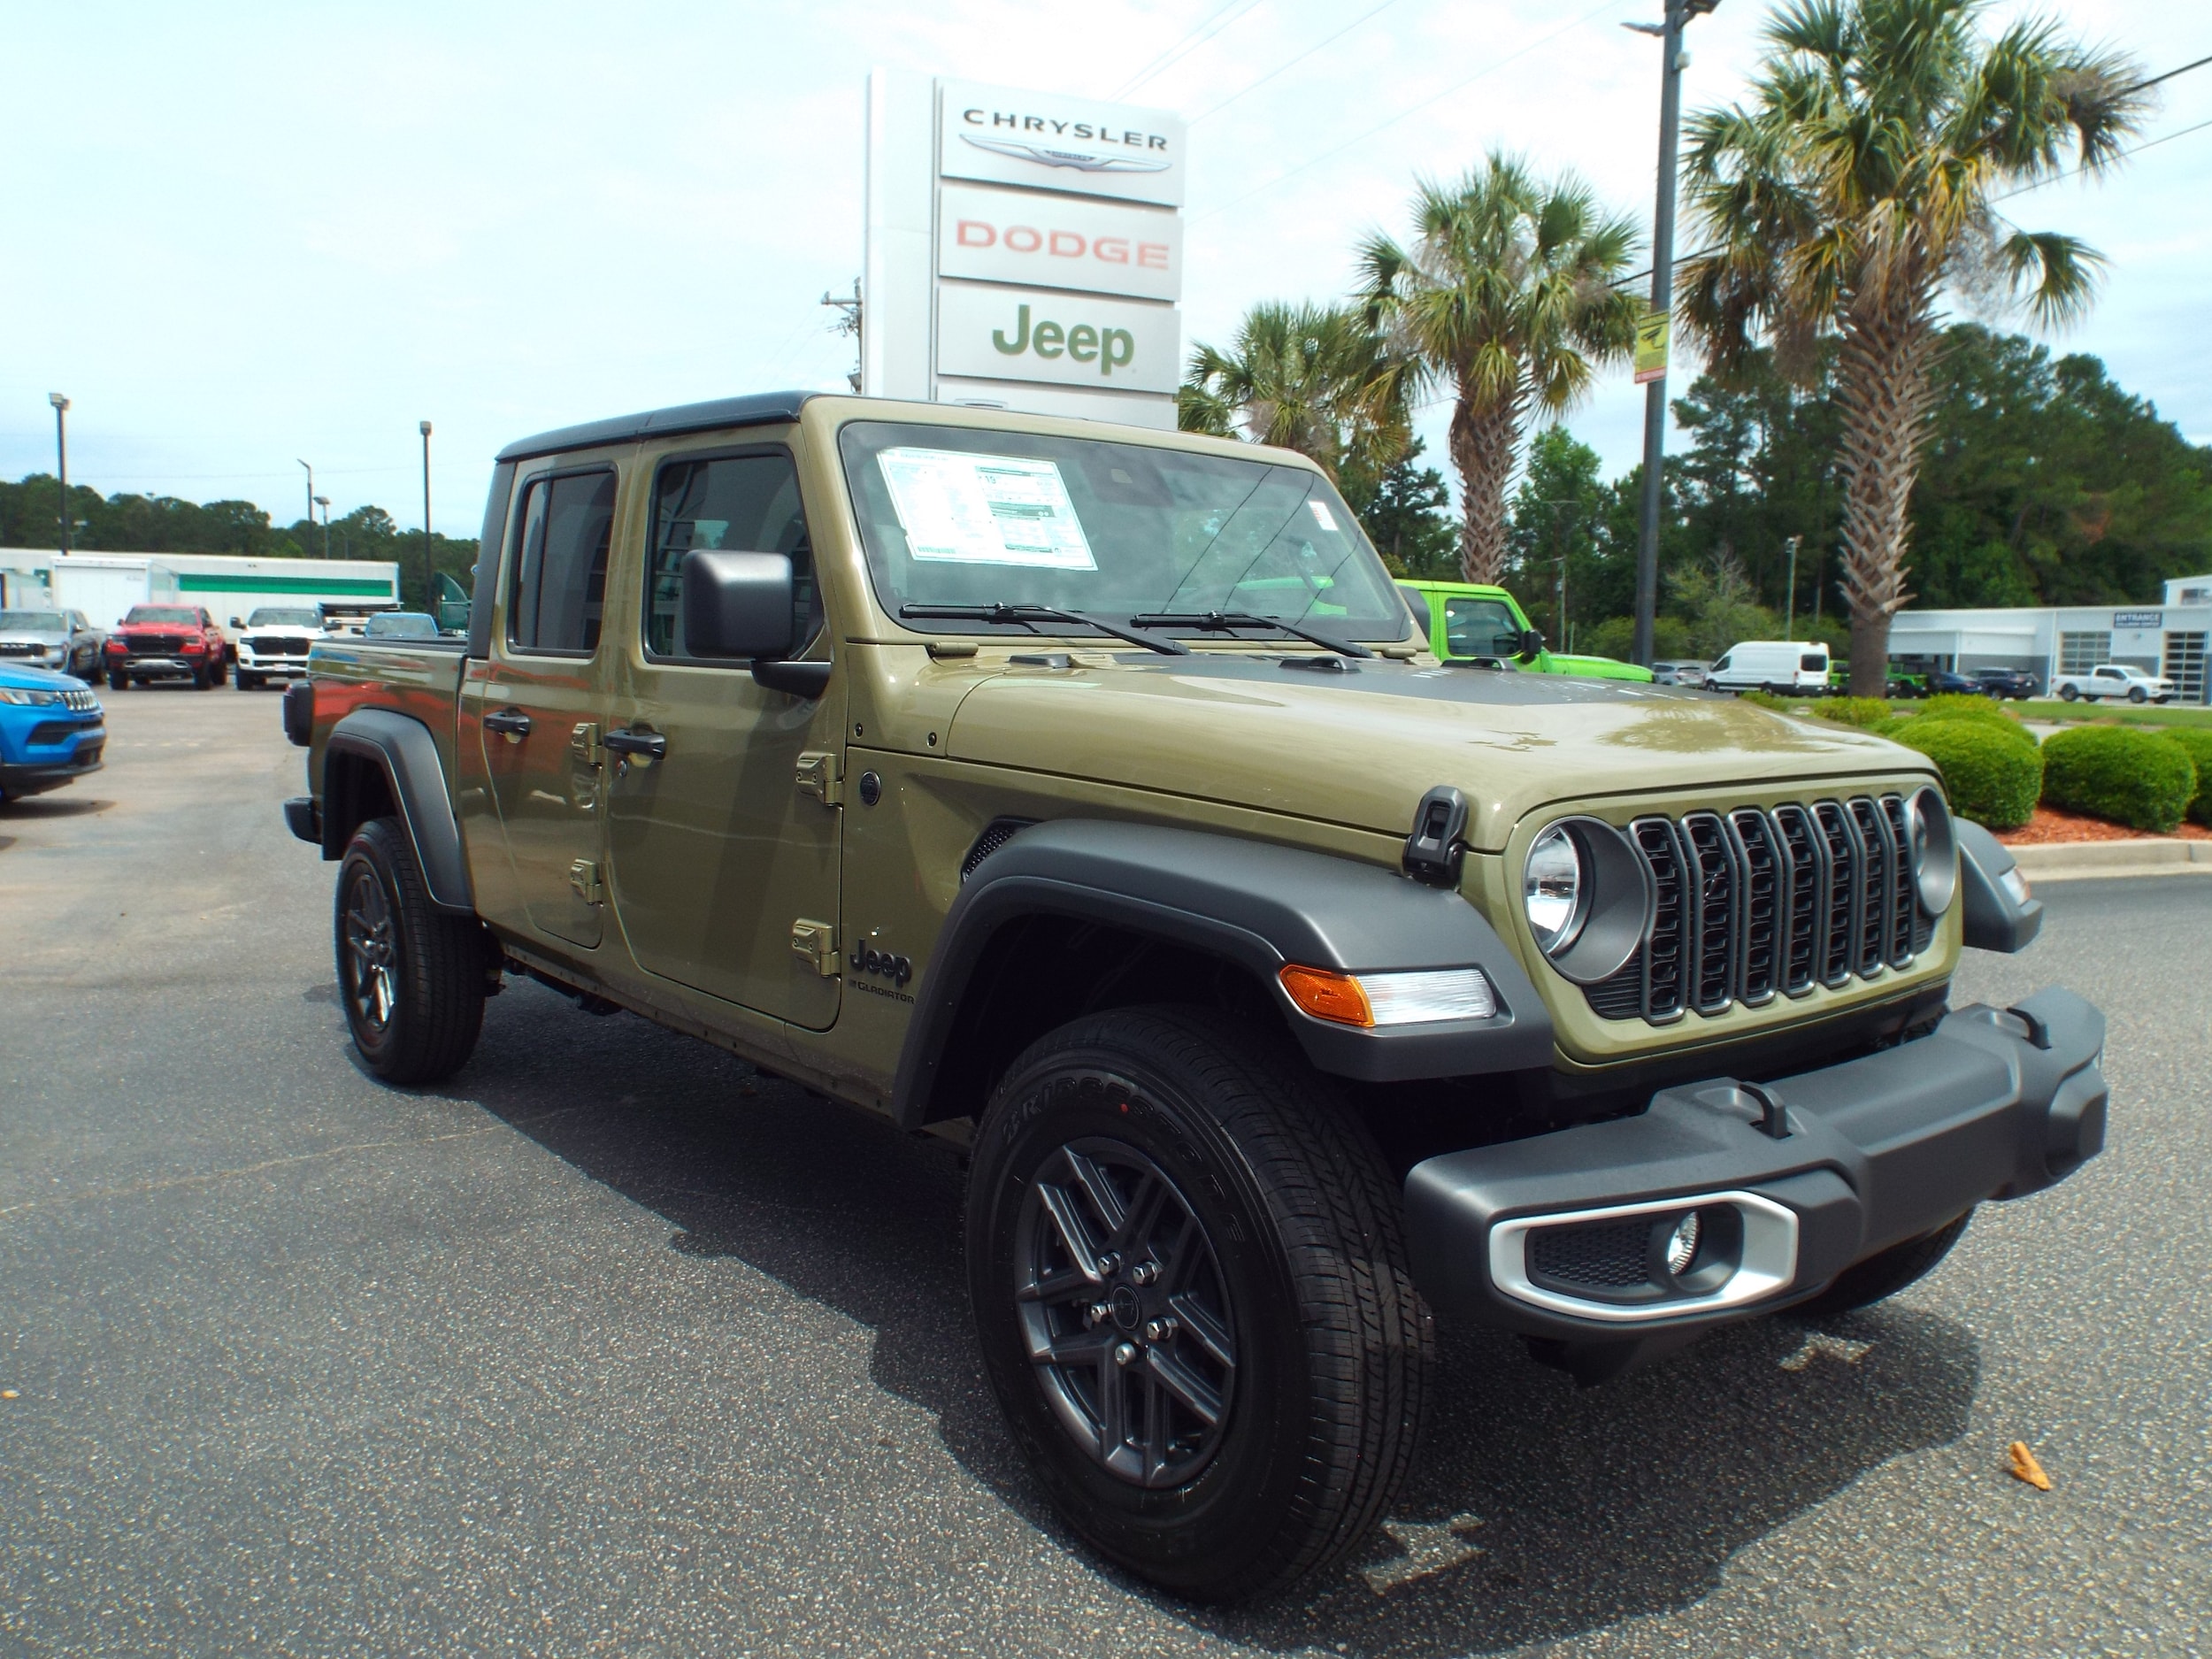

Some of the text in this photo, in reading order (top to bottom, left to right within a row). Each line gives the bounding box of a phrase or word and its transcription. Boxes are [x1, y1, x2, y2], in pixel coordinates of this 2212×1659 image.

[964, 109, 1167, 150] CHRYSLER
[957, 220, 1169, 269] DODGE
[992, 303, 1135, 376] Jeep
[850, 939, 912, 988] Jeep
[857, 982, 914, 1003] GLADIATOR
